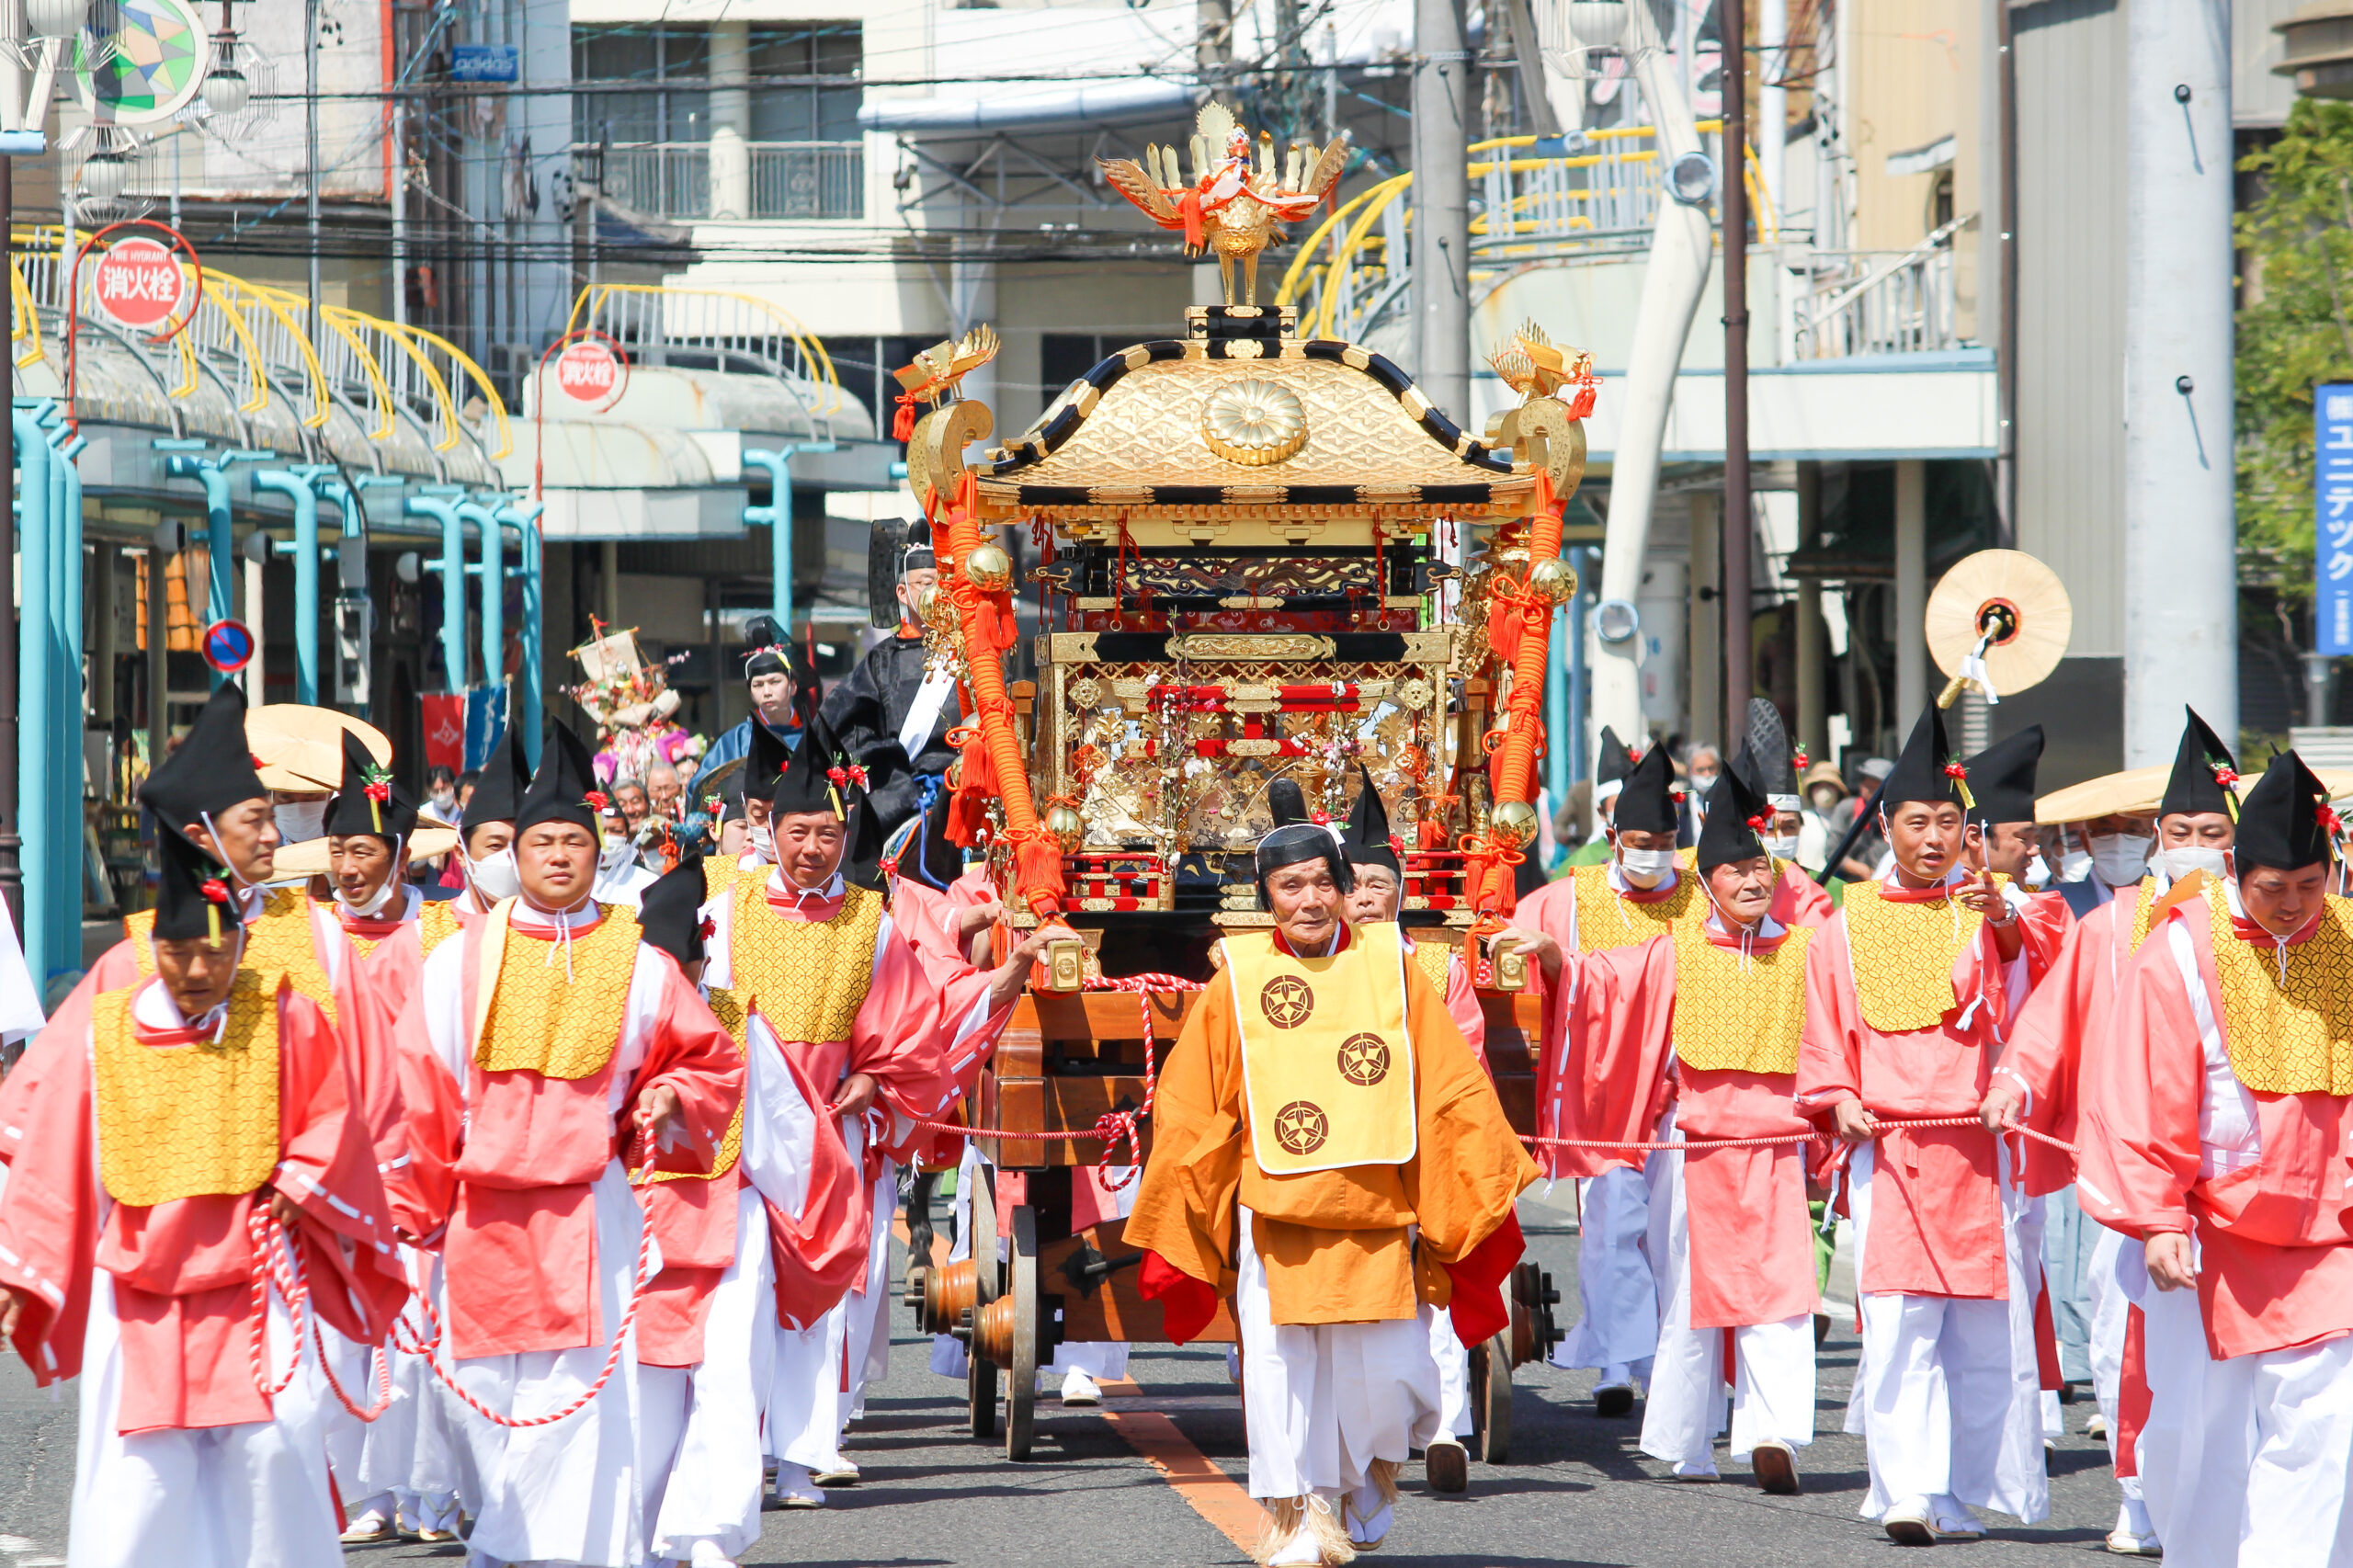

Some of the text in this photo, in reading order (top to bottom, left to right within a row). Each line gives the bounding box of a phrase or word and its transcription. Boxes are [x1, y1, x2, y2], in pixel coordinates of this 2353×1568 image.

[110, 250, 167, 263] FIRE HYDRANT
[104, 266, 176, 301] 消火栓
[563, 360, 612, 386] 消火栓
